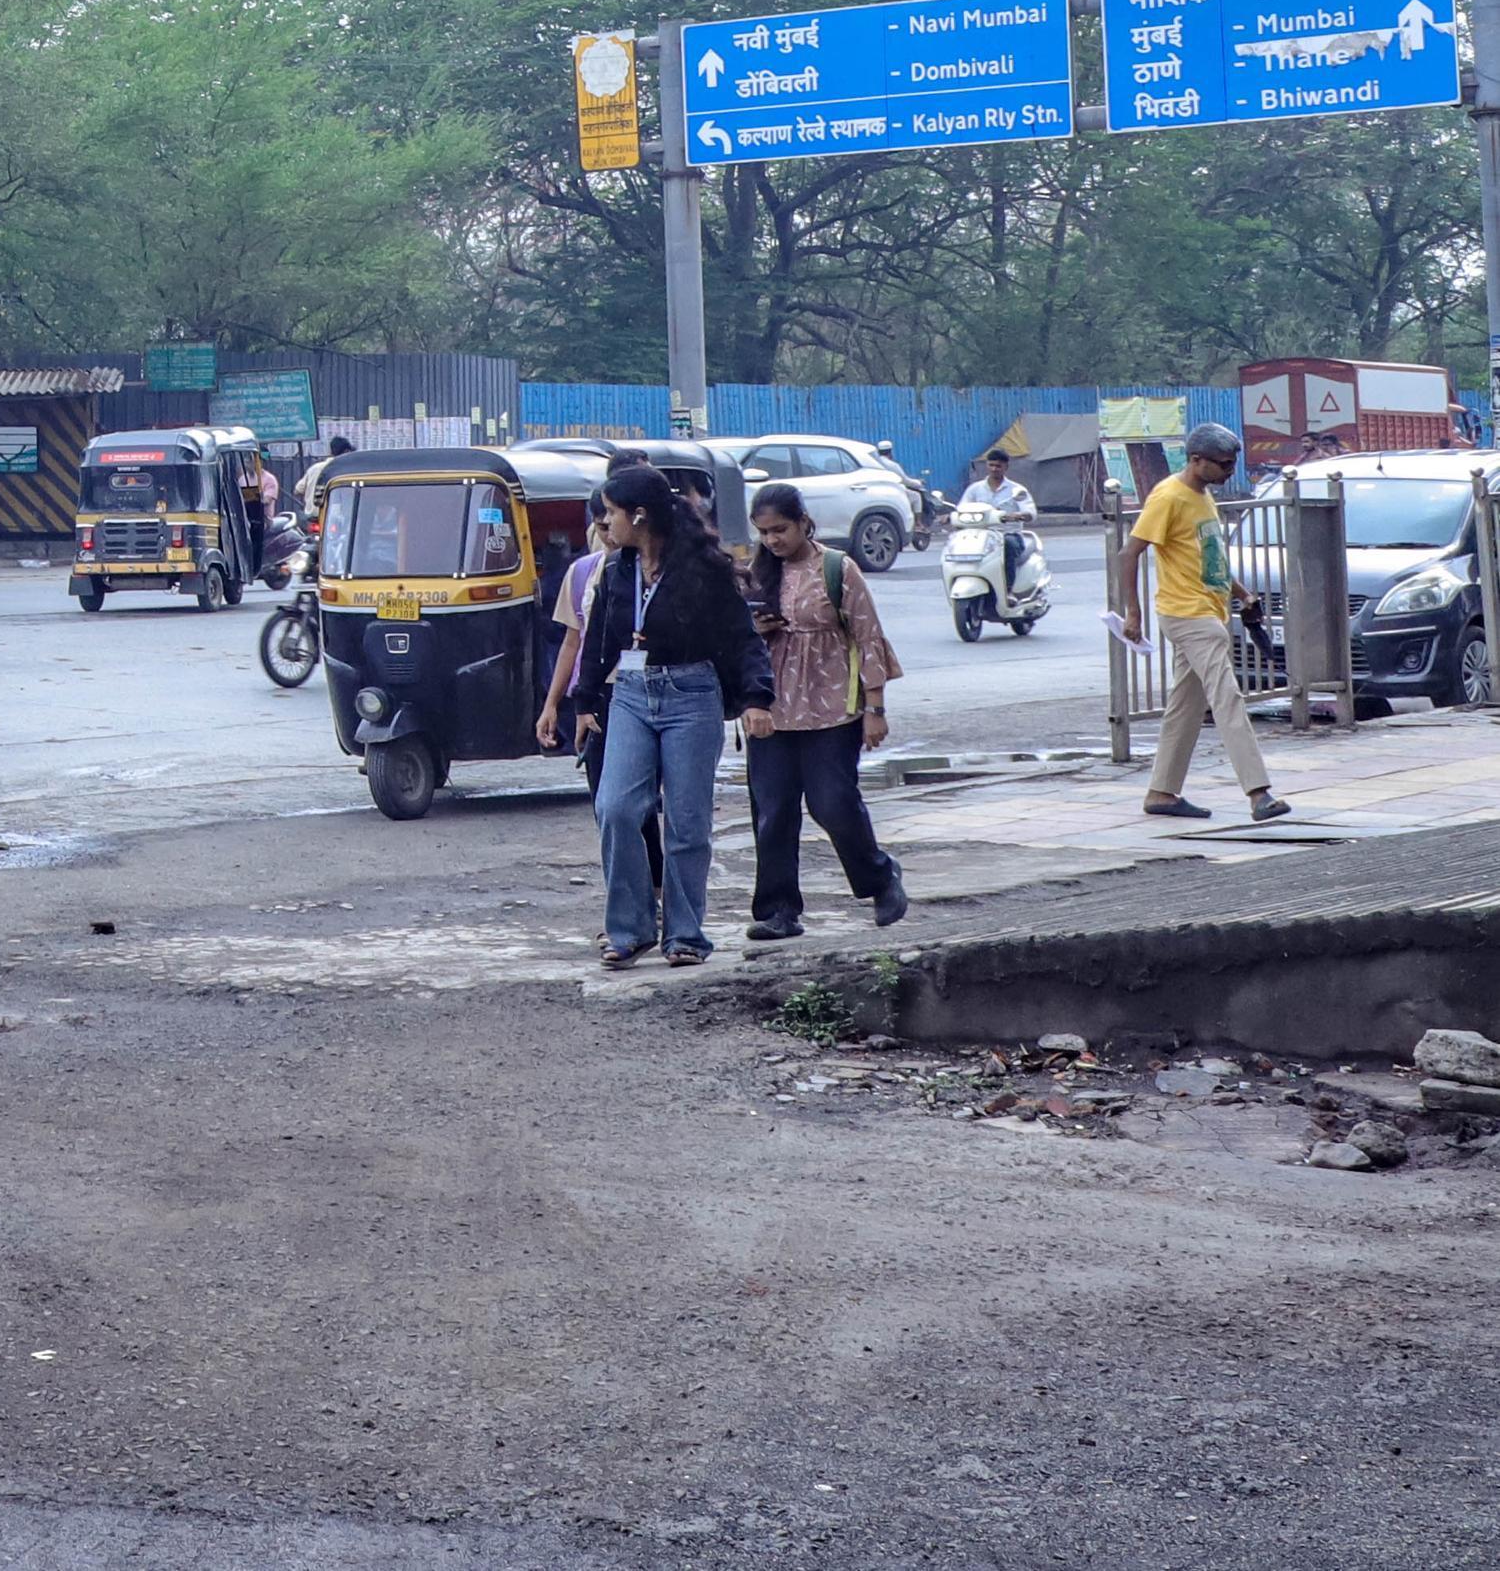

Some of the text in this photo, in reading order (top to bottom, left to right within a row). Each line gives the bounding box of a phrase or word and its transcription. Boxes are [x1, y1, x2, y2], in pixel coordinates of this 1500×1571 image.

[909, 15, 956, 35] Navi
[963, 3, 1047, 30] Mumbai
[1130, 16, 1183, 53] मुंबई
[1257, 6, 1355, 35] Mumbai
[733, 19, 820, 53] नवी मुंबई
[735, 65, 820, 99] डोंबिवली
[911, 55, 1014, 82] Dombivali
[1133, 53, 1182, 84] ठाणे
[1134, 88, 1200, 120] भिवंडी
[1260, 80, 1380, 110] Bhiwandi
[737, 115, 887, 148] कल्याण रेल्वे स्थानक
[913, 110, 980, 136] Kalyan
[984, 107, 1015, 131] Rly
[1021, 104, 1063, 126] Stn.
